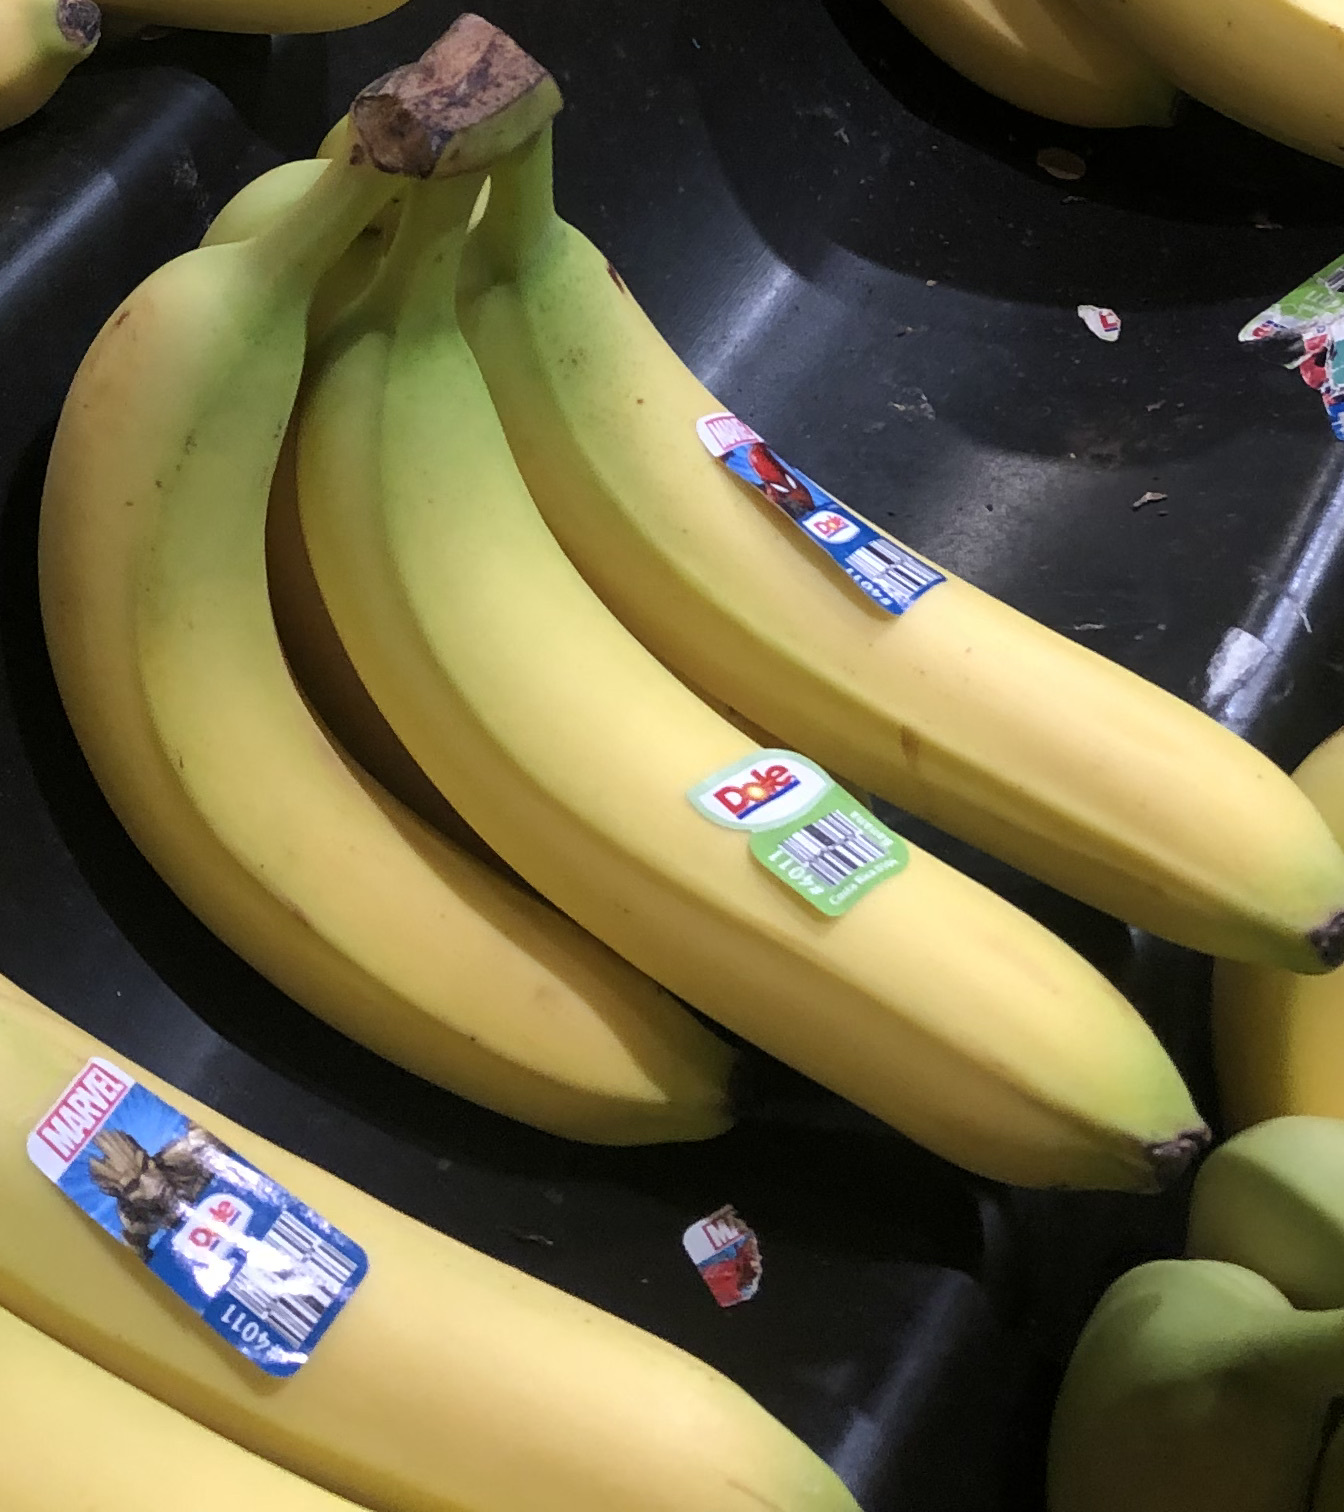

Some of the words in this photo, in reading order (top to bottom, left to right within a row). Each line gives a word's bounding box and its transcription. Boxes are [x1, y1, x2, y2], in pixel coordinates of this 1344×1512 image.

[713, 764, 794, 815] Dole
[768, 850, 825, 895] #4011
[39, 1065, 126, 1158] MARVEL
